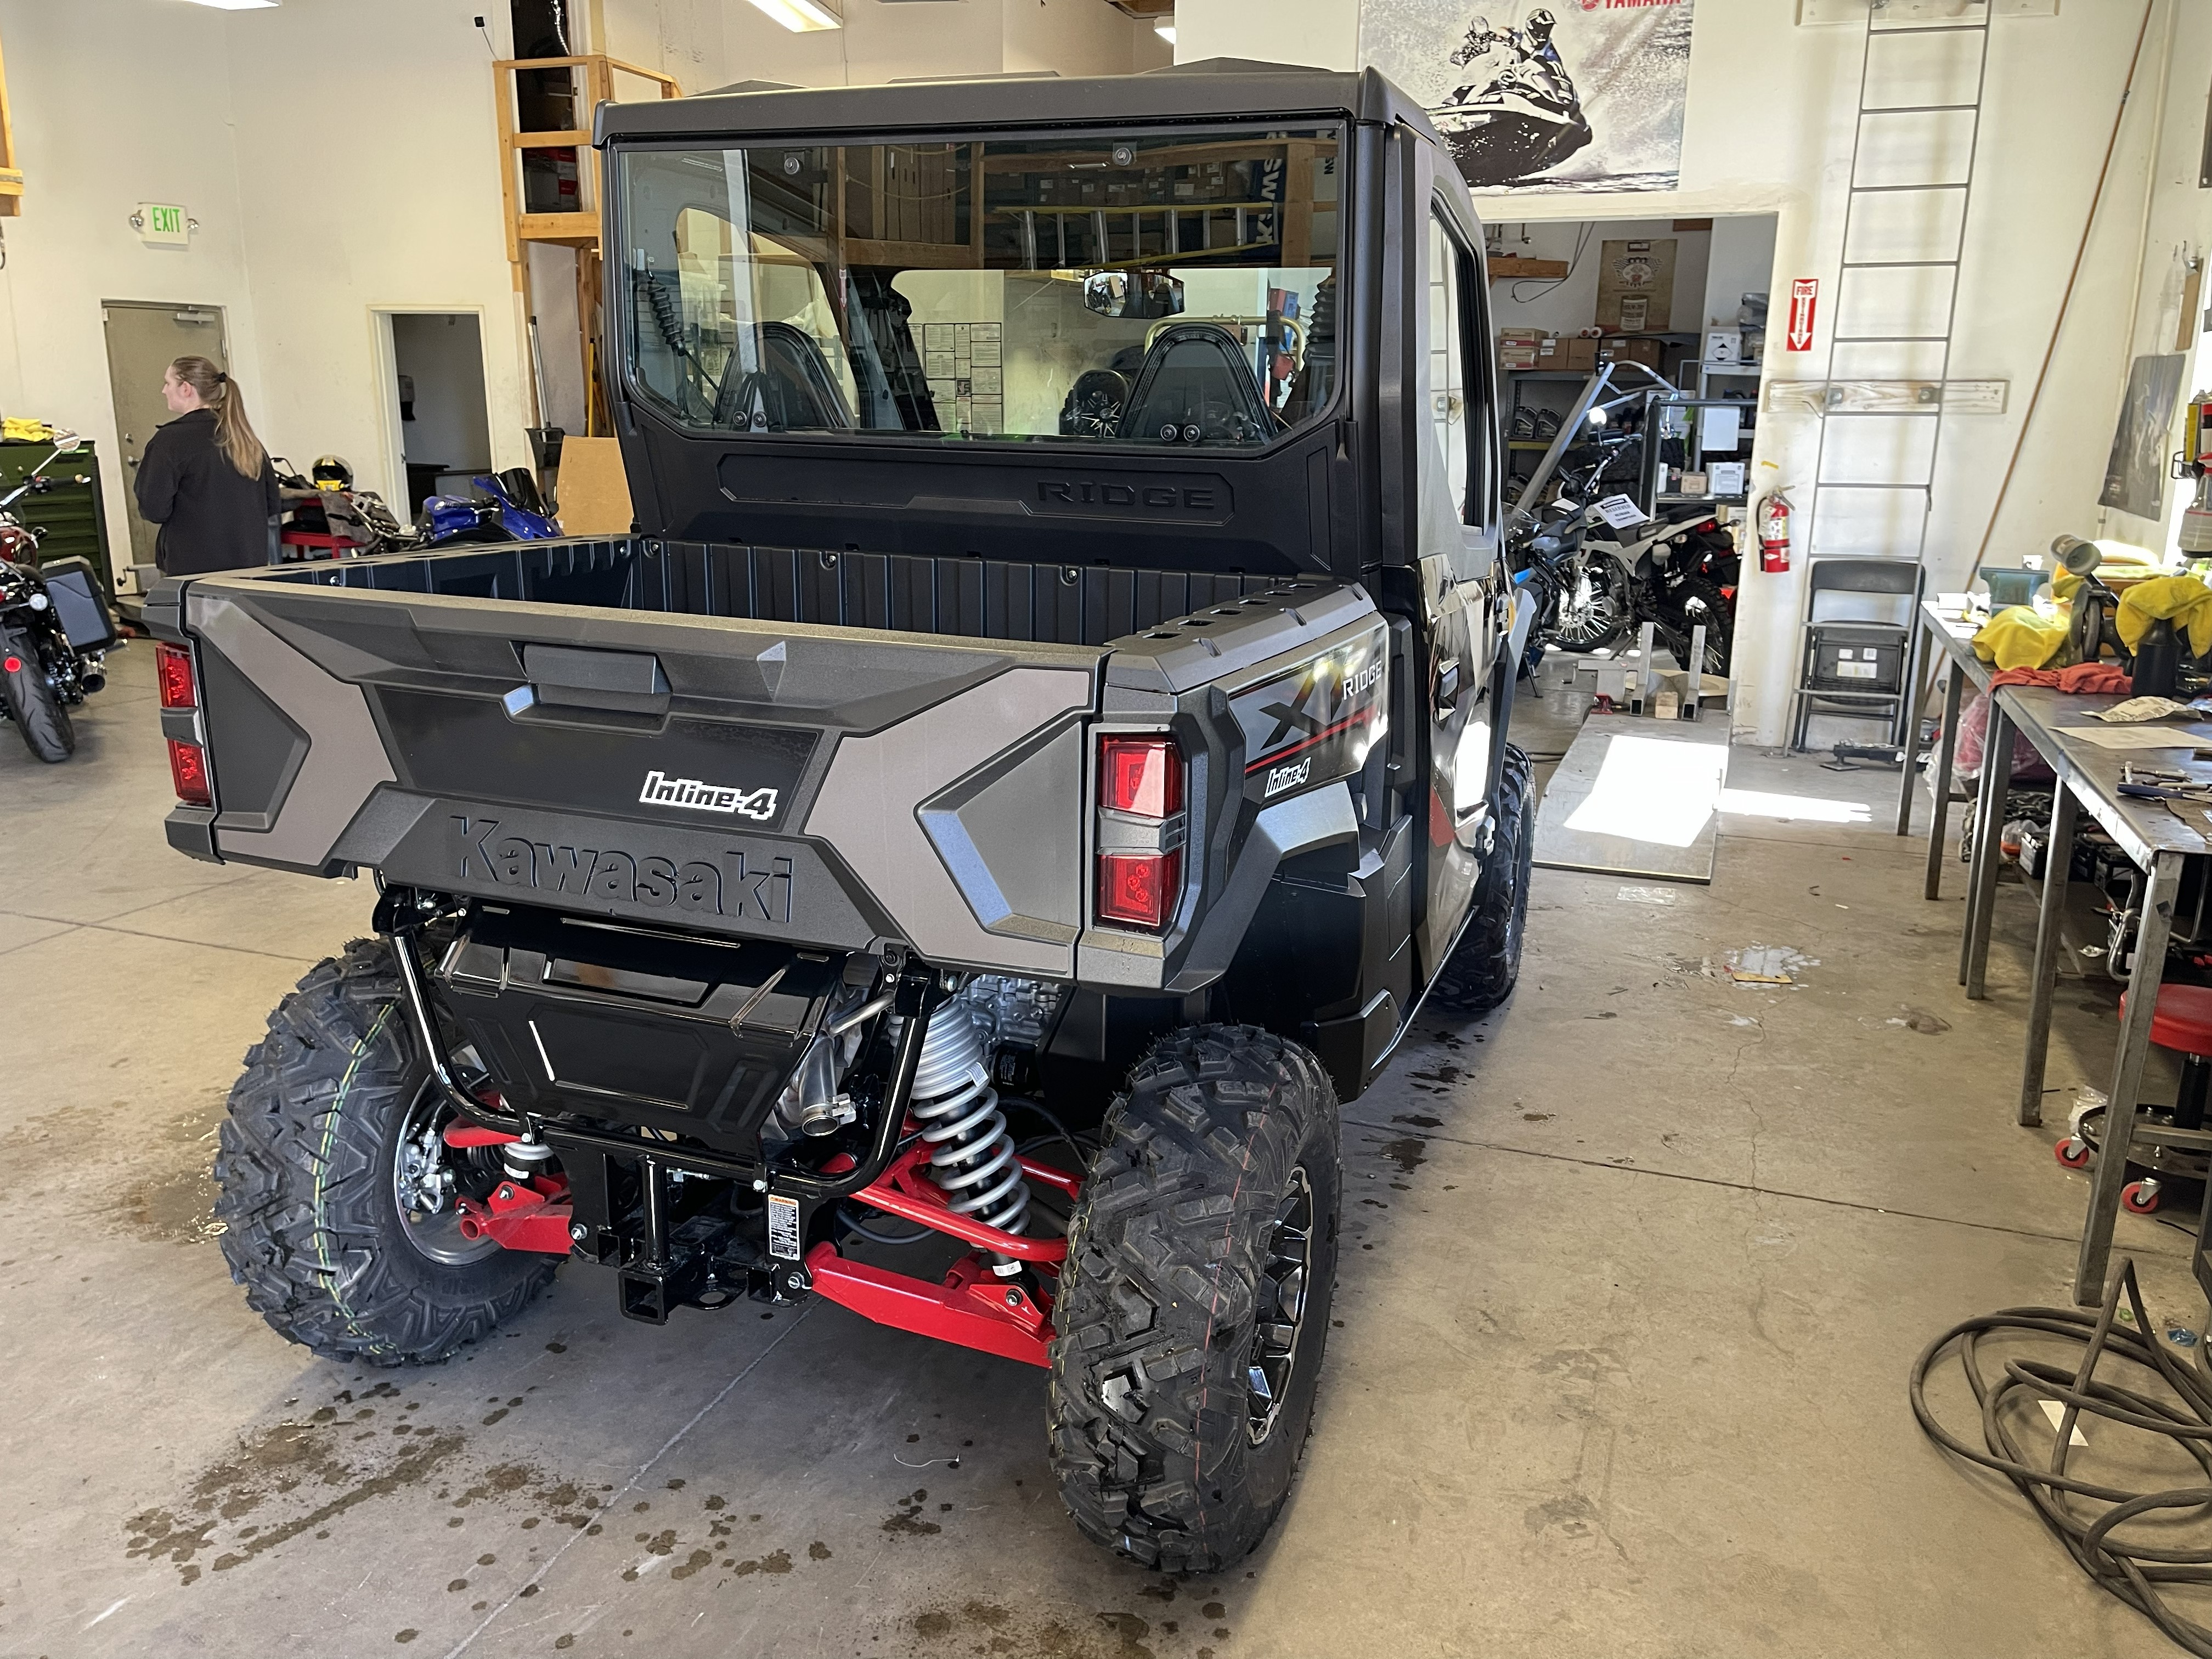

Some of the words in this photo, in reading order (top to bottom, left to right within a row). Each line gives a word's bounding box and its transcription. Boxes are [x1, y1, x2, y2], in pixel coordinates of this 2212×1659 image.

[1605, 0, 1681, 9] YAM
[153, 207, 180, 233] EXIT
[1796, 286, 1813, 295] FIRE
[1037, 481, 1215, 509] RIDGE
[1343, 660, 1382, 700] RIDGE
[1265, 757, 1311, 798] Inline-4
[639, 770, 778, 820] Inline-4
[447, 815, 794, 923] Kawasaki
